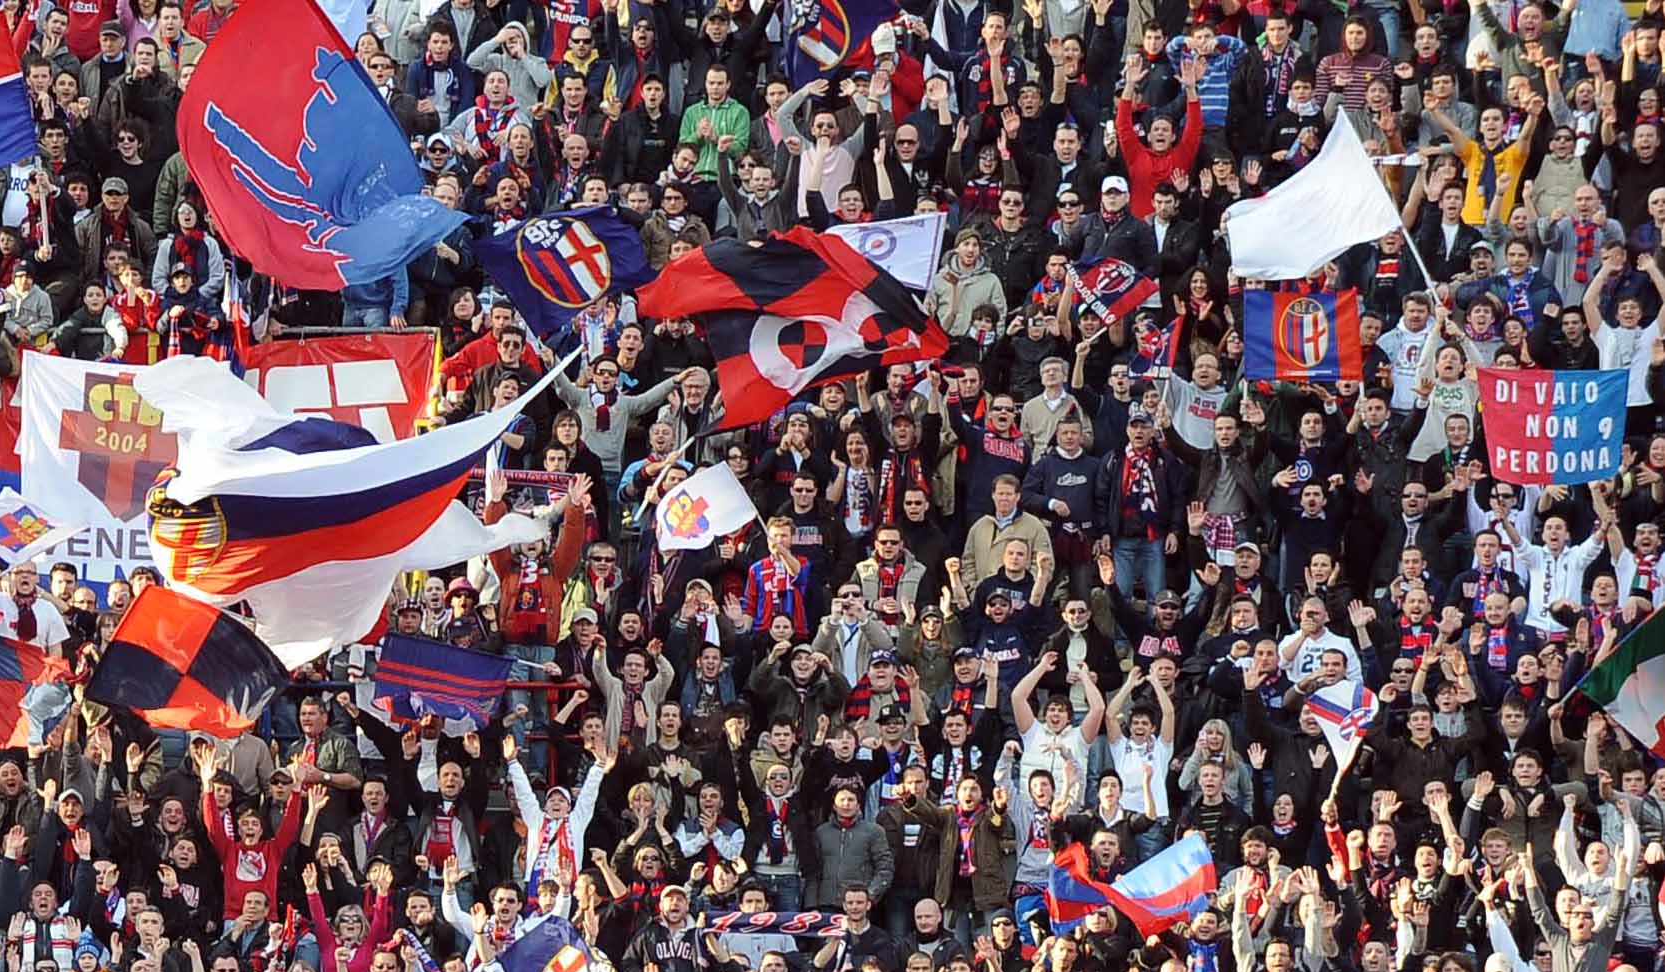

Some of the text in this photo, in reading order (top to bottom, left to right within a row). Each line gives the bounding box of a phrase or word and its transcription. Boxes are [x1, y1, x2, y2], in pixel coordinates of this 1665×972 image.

[525, 219, 562, 245] BFC
[1495, 379, 1599, 405] DI VAIO
[95, 426, 149, 452] 2004
[1525, 414, 1614, 440] NON 9
[1495, 446, 1611, 473] PERDONA
[46, 527, 153, 561] ENE
[705, 911, 846, 936] 1982
